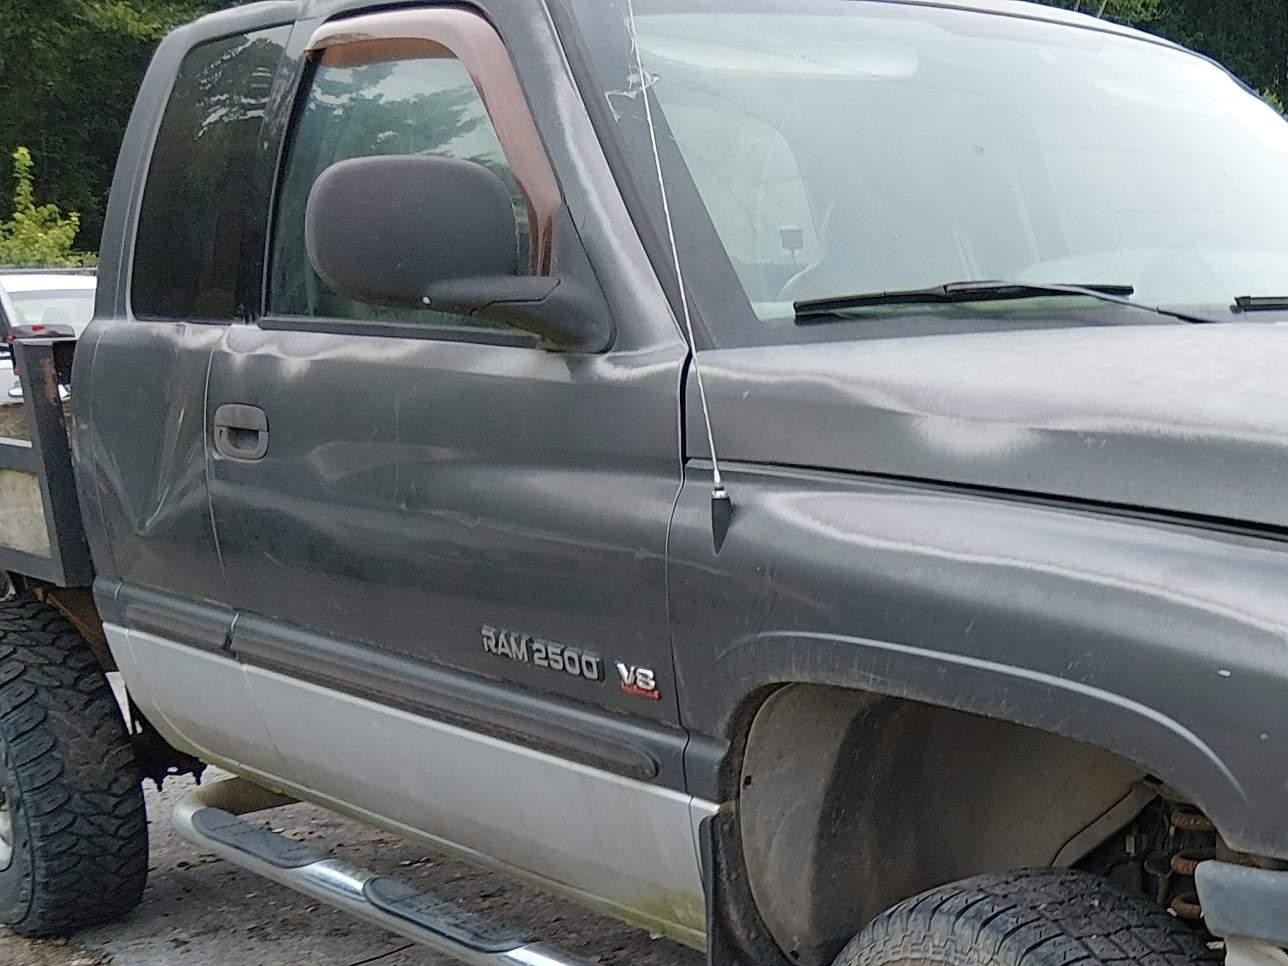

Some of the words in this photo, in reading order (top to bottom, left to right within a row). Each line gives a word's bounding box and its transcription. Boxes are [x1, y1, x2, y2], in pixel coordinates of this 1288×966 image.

[481, 626, 529, 663] RAM
[532, 641, 600, 680] 2500
[616, 662, 656, 690] V8
